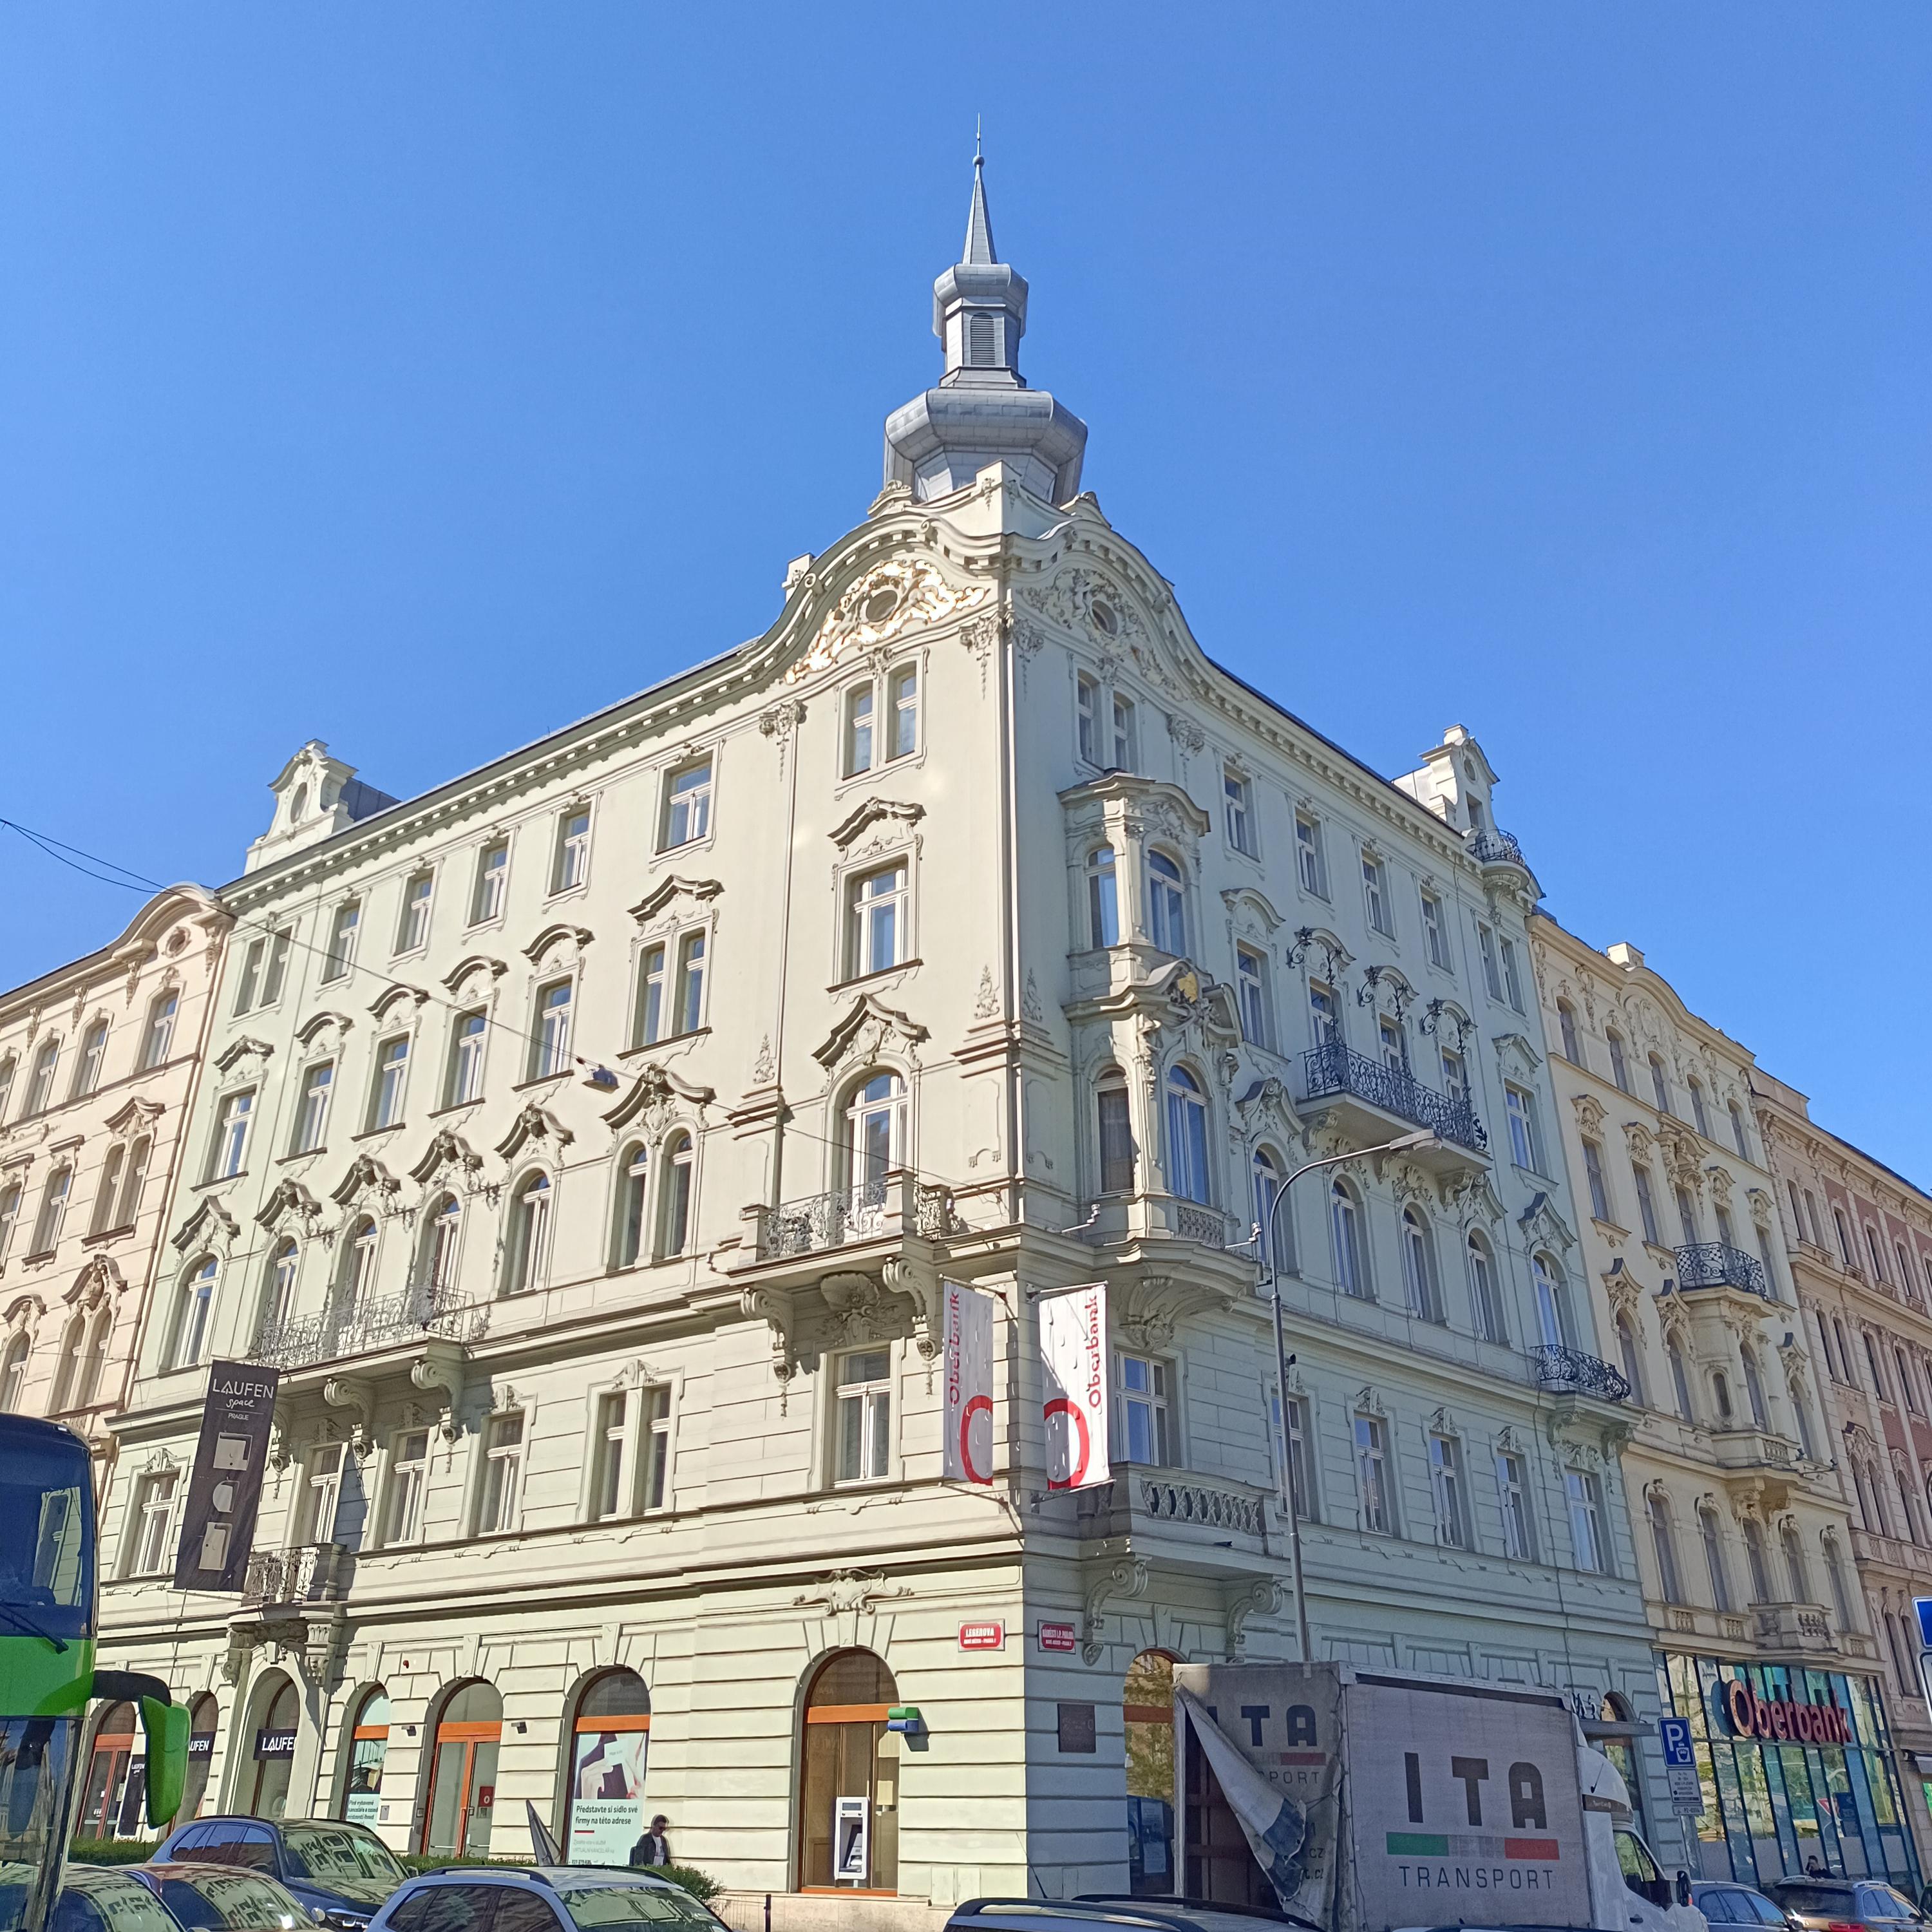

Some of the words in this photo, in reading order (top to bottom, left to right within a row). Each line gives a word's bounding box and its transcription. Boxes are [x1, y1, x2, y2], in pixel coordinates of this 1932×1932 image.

[949, 1292, 960, 1405] Oberbank
[1084, 1294, 1101, 1408] Oberbank
[213, 1378, 274, 1399] LAUFEN
[226, 1399, 255, 1409] space
[1730, 1679, 1853, 1744] Oberbank
[189, 1740, 209, 1752] UFEN
[1665, 1724, 1683, 1752] P
[1405, 1752, 1548, 1829] ITA
[576, 1817, 591, 1826] firmy
[1399, 1866, 1553, 1889] TRANSPORT
